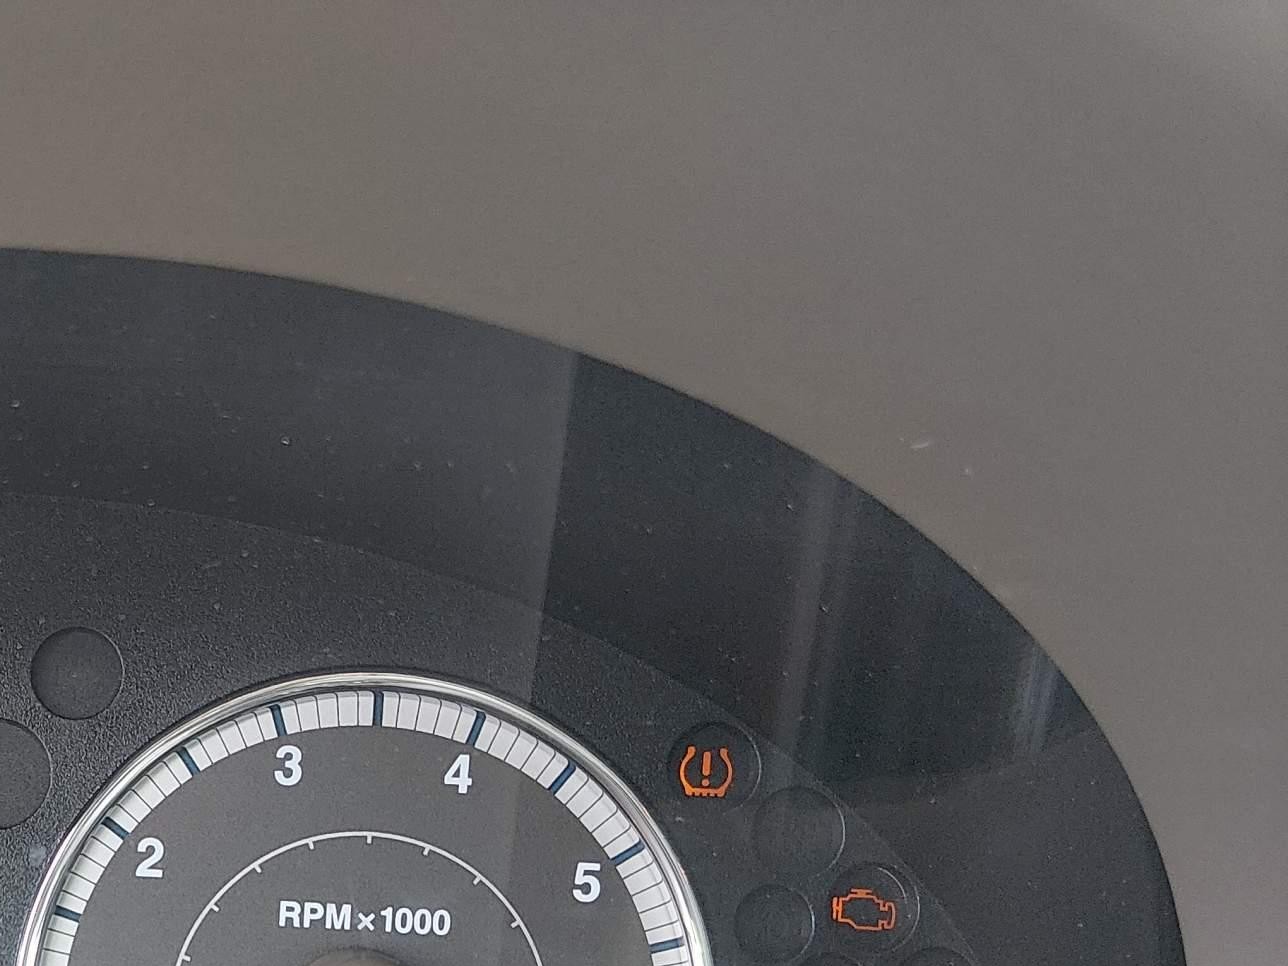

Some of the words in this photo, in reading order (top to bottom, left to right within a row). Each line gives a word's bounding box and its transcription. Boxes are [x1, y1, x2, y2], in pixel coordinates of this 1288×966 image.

[275, 745, 302, 785] 3
[444, 755, 472, 793] 4
[136, 838, 163, 877] 2
[573, 863, 600, 902] 5
